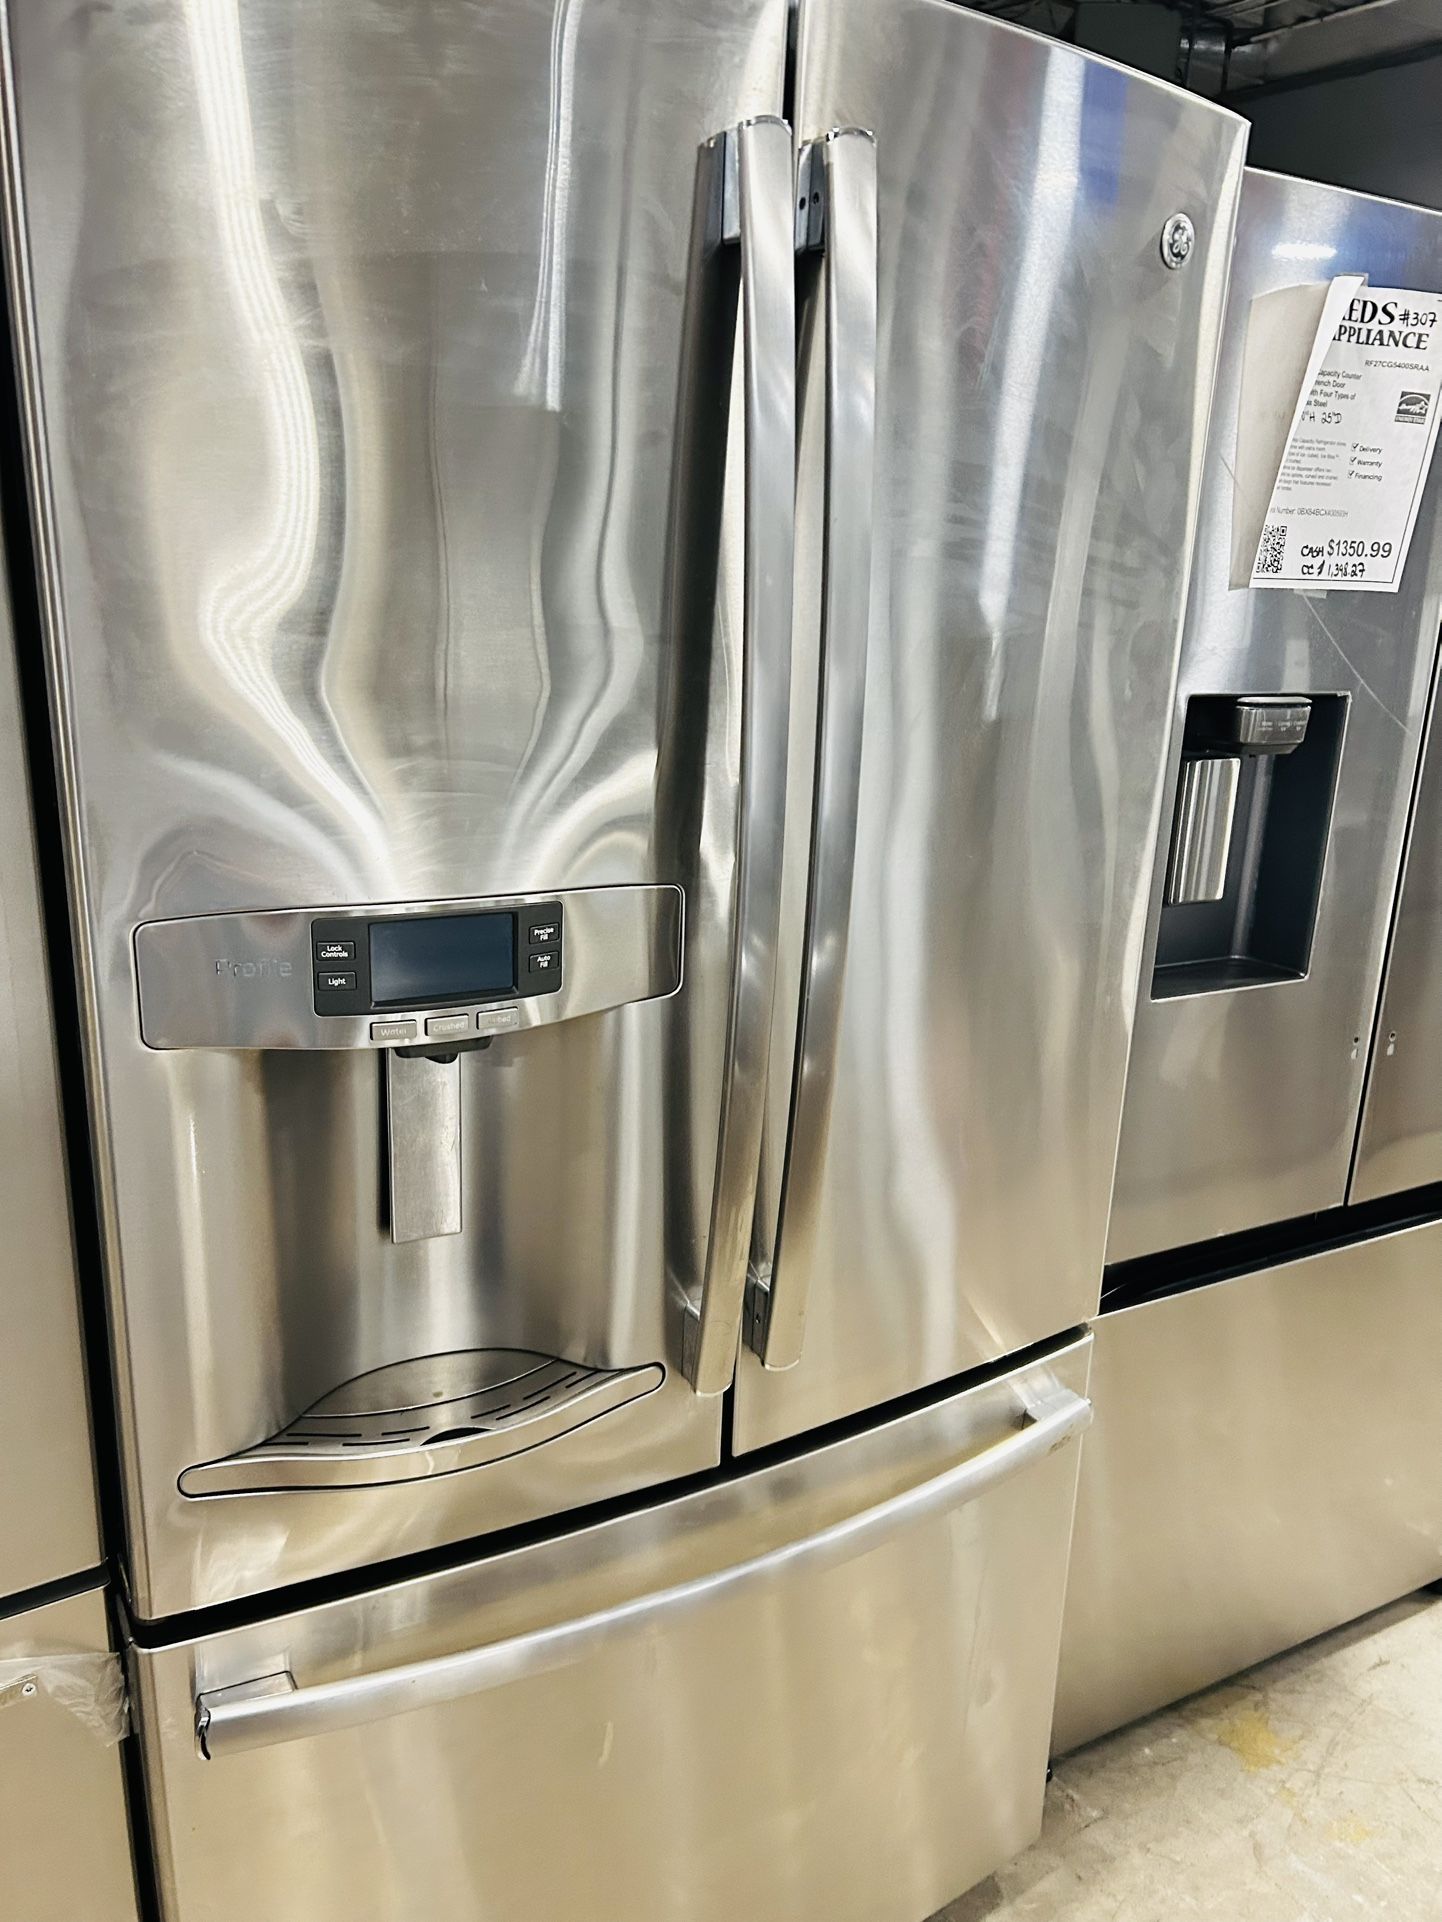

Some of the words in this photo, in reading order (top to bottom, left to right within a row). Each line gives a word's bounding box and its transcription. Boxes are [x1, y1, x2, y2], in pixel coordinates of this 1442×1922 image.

[1399, 309, 1437, 327] #307
[1314, 379, 1331, 387] rench
[1332, 380, 1346, 388] Door
[1335, 391, 1349, 400] Types
[1313, 399, 1328, 407] Steel
[1359, 445, 1383, 454] Delivery
[1357, 459, 1383, 468] Warranty
[1355, 472, 1383, 481] Financing
[1301, 545, 1324, 558] CASH
[1327, 539, 1392, 558] $1350.99
[534, 927, 554, 936] Precise
[540, 933, 548, 941] Fill
[215, 958, 292, 977] Profile
[328, 978, 346, 986] Light
[381, 1027, 407, 1036] Water
[433, 1022, 465, 1032] Crushed
